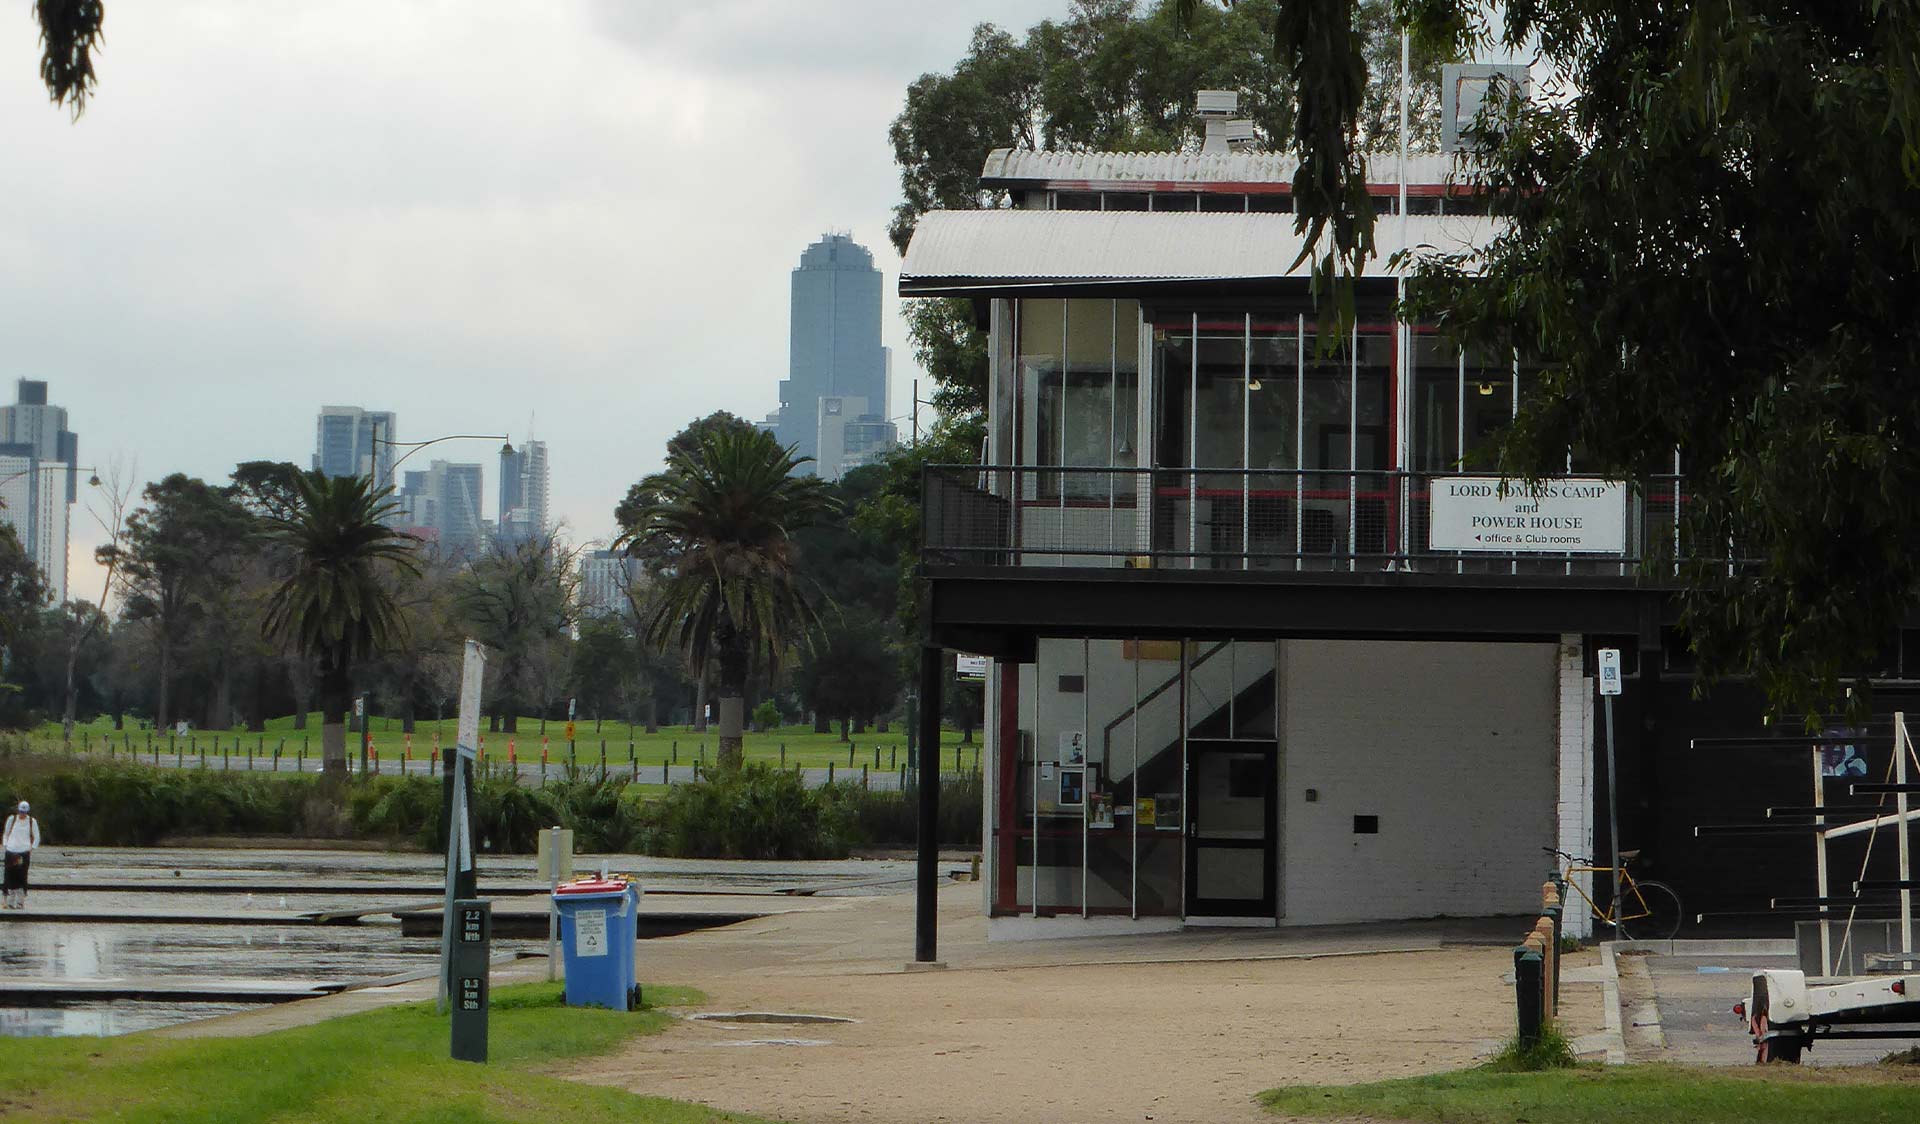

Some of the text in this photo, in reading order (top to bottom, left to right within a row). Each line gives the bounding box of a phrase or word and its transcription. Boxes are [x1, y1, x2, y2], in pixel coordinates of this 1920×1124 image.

[1450, 485, 1606, 499] LORD OMRS CAMP
[1515, 503, 1539, 513] and
[1472, 516, 1583, 529] POWER HOUSE
[1484, 533, 1581, 544] office & Club rooms
[1605, 651, 1614, 663] P
[465, 910, 480, 921] 2.2
[465, 922, 480, 931] km
[464, 932, 481, 941] Nth
[464, 979, 479, 989] 0.3
[464, 990, 478, 999] km
[463, 1001, 479, 1010] Sth
